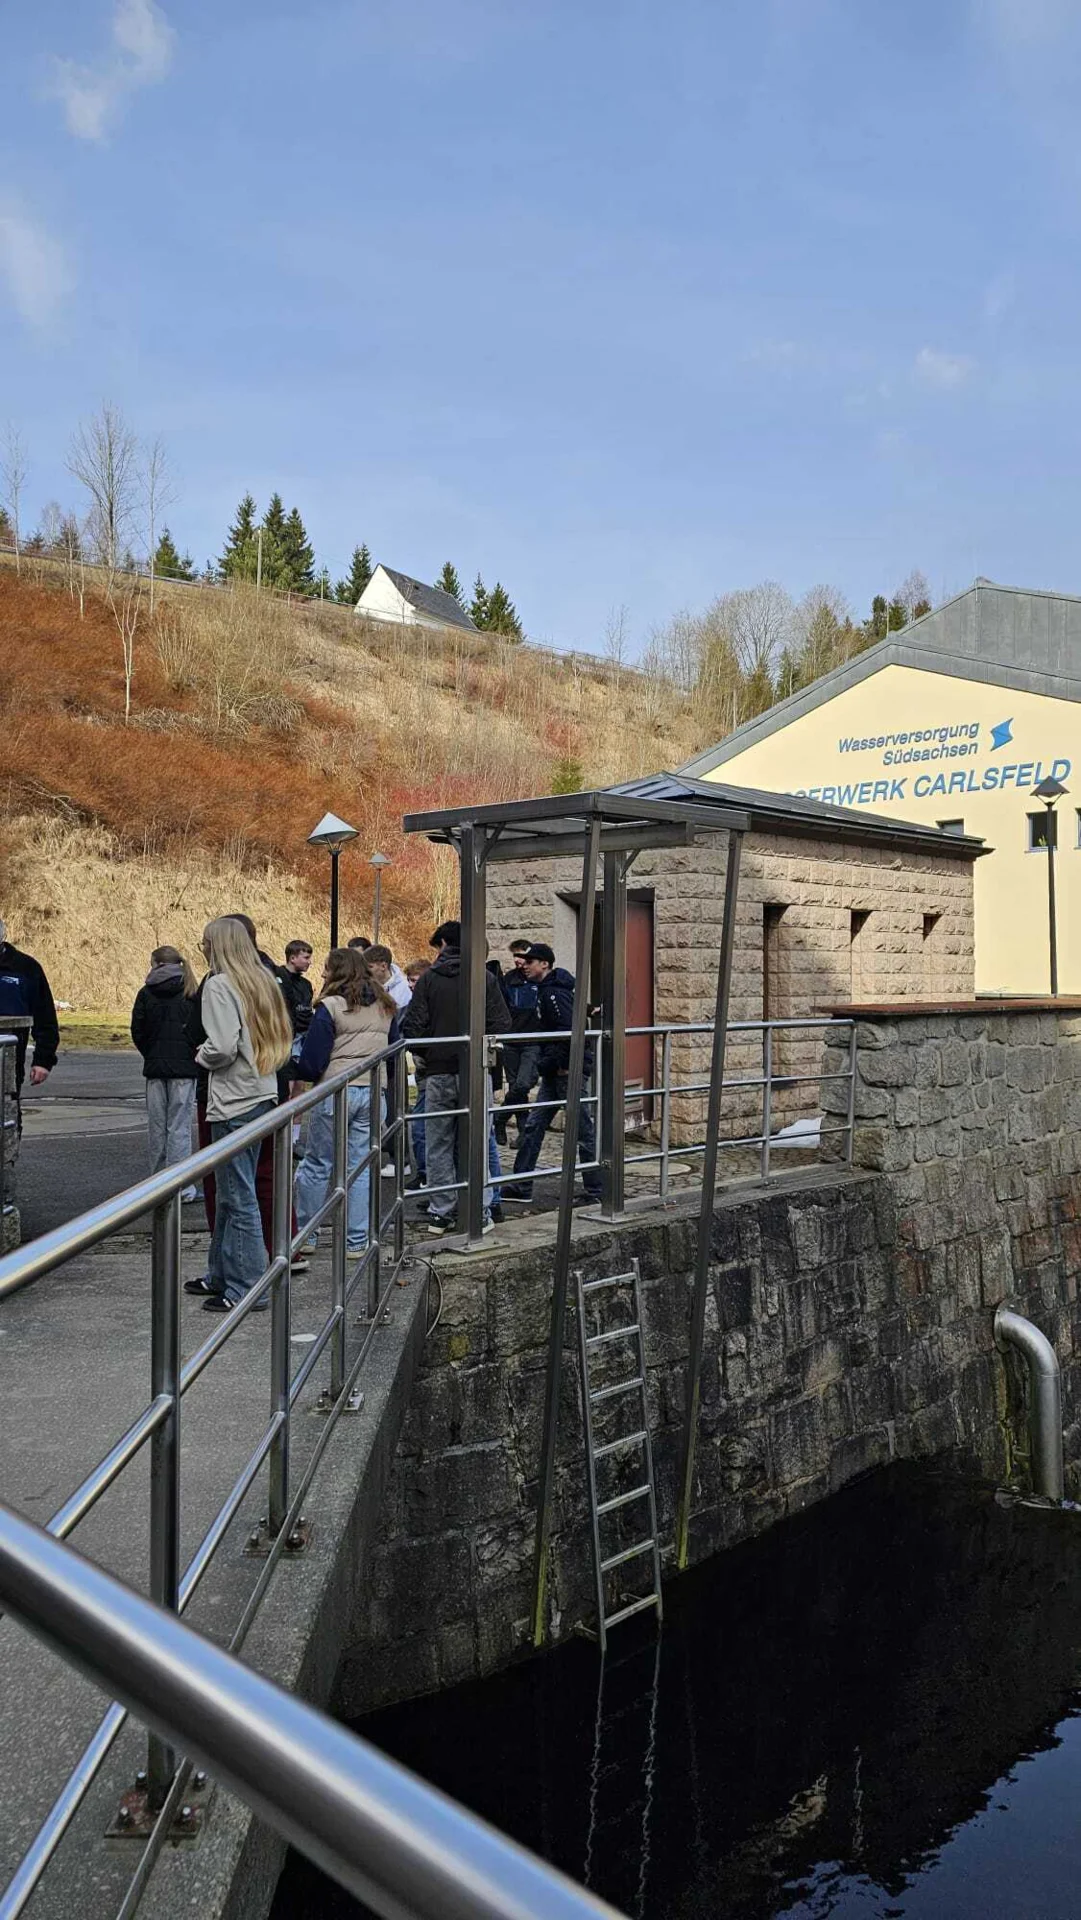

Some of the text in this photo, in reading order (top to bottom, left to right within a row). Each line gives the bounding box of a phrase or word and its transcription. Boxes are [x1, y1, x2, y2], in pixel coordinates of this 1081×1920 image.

[838, 722, 980, 753] Wasserversorgung
[882, 742, 979, 766] Südsachsen
[786, 758, 1072, 806] ERWERK CARLSFELD
